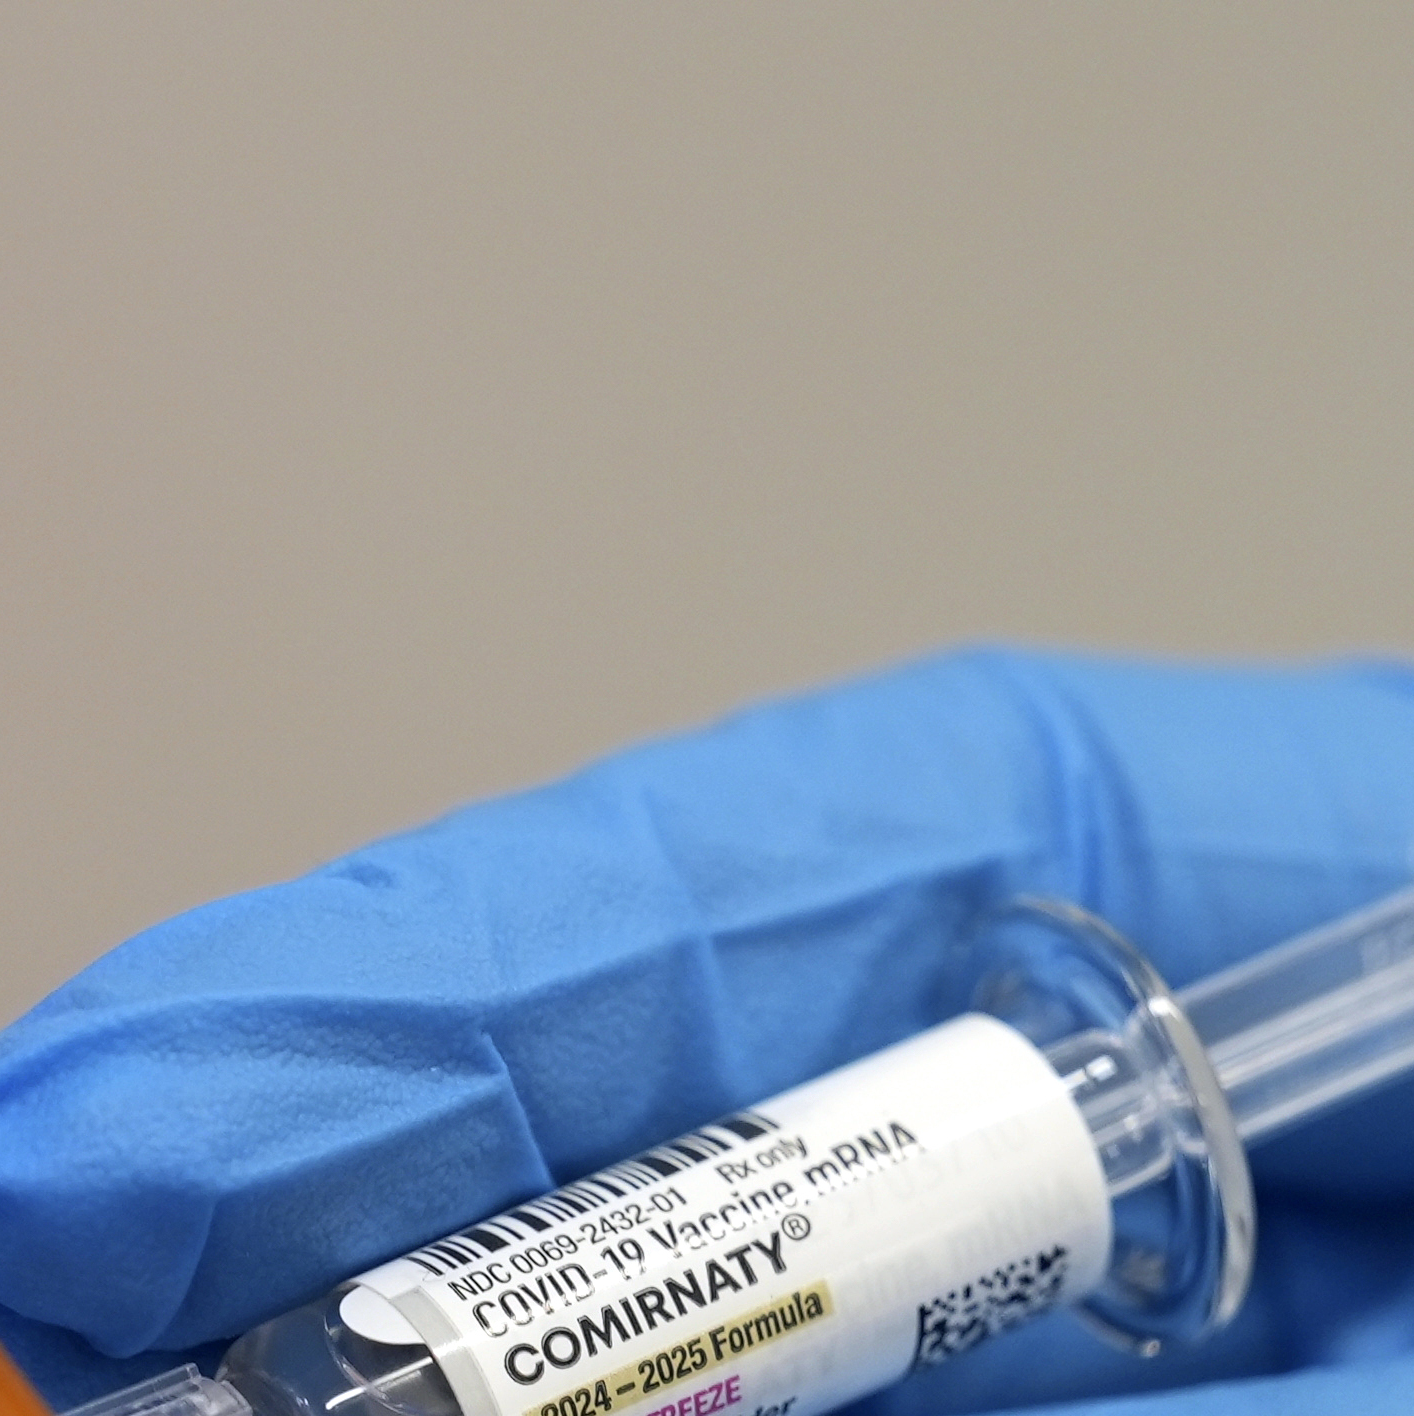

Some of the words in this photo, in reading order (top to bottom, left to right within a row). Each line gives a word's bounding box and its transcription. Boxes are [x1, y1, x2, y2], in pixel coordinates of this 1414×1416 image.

[447, 1262, 512, 1302] NDC
[509, 1186, 687, 1275] 0069-2432-01
[715, 1160, 757, 1184] Rx
[756, 1135, 808, 1169] only
[472, 1237, 646, 1337] COVID-19
[803, 1120, 925, 1198] mRNA
[637, 1338, 707, 1393] 2025
[708, 1291, 824, 1361] Formula
